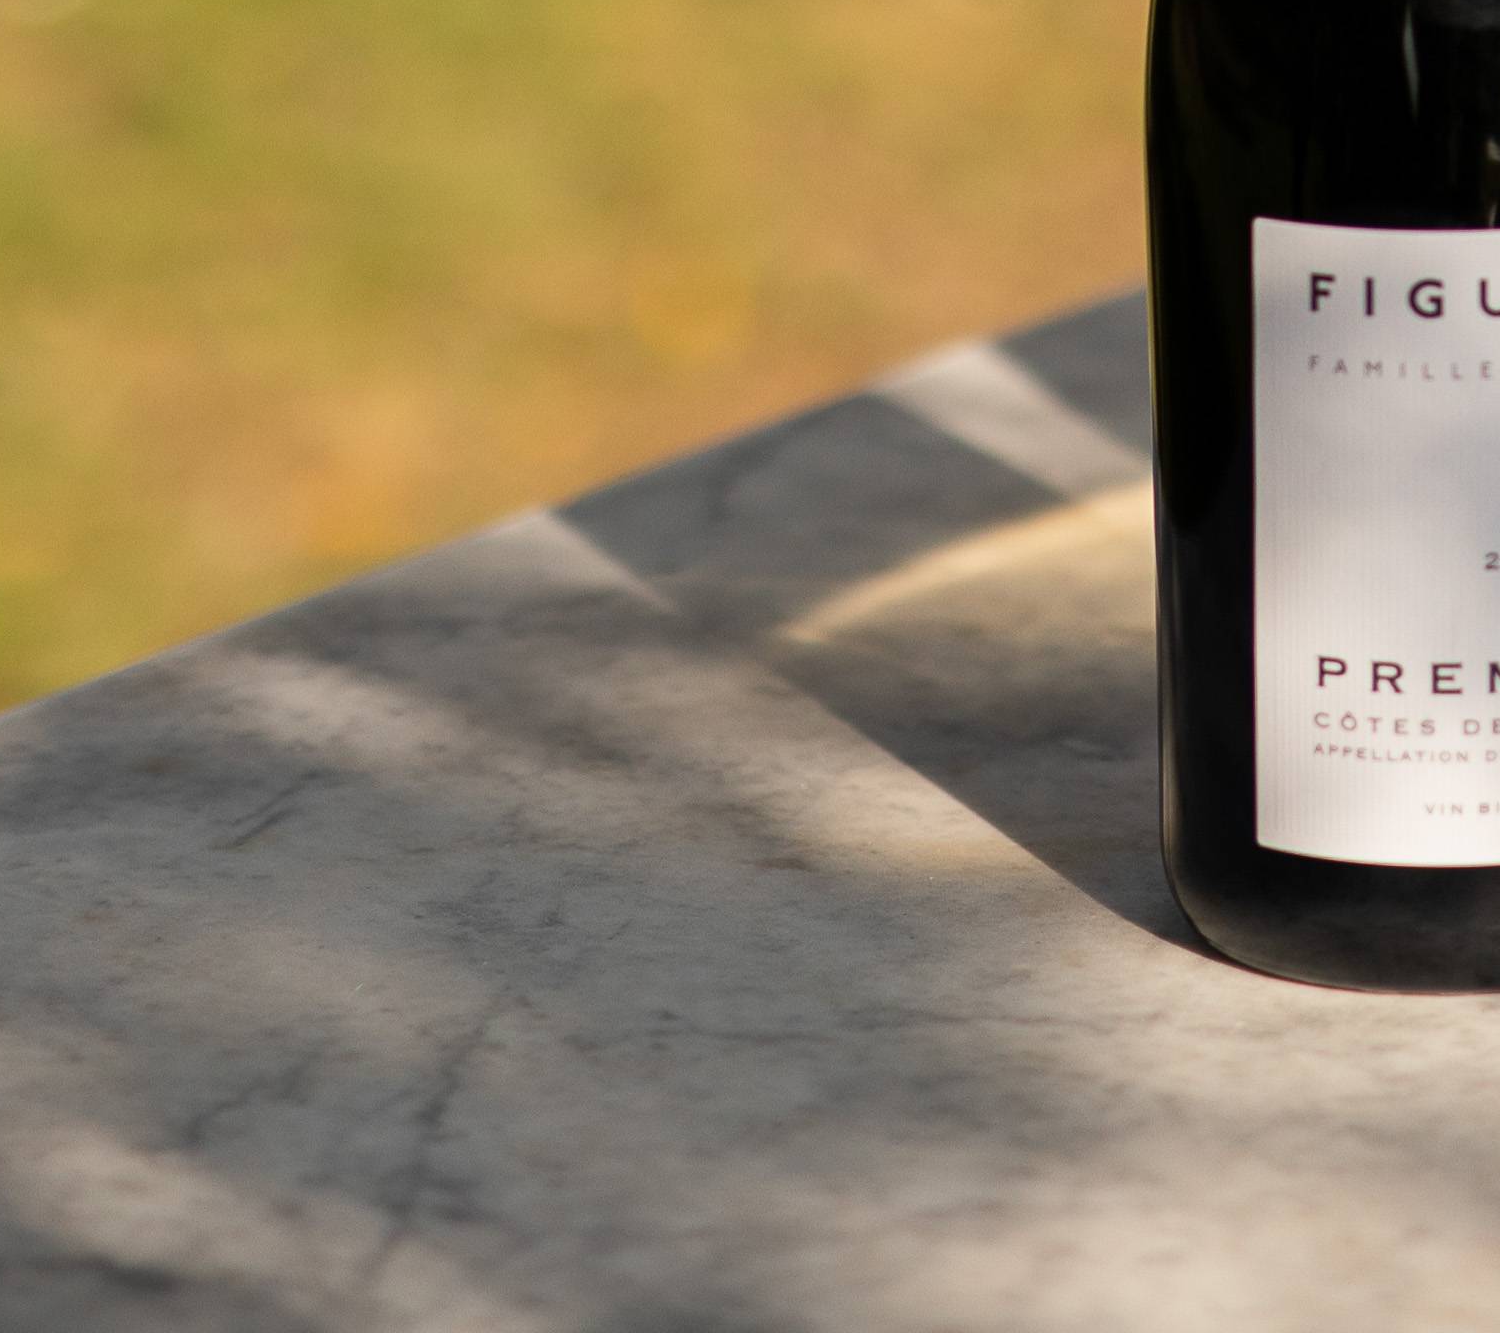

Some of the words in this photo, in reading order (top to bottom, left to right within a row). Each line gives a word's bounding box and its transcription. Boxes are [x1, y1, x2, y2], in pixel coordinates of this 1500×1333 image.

[1307, 354, 1493, 382] FAMILLE
[1312, 710, 1437, 737] CÔTES
[1313, 742, 1470, 764] APPELLATION
[1424, 803, 1464, 816] VIN
